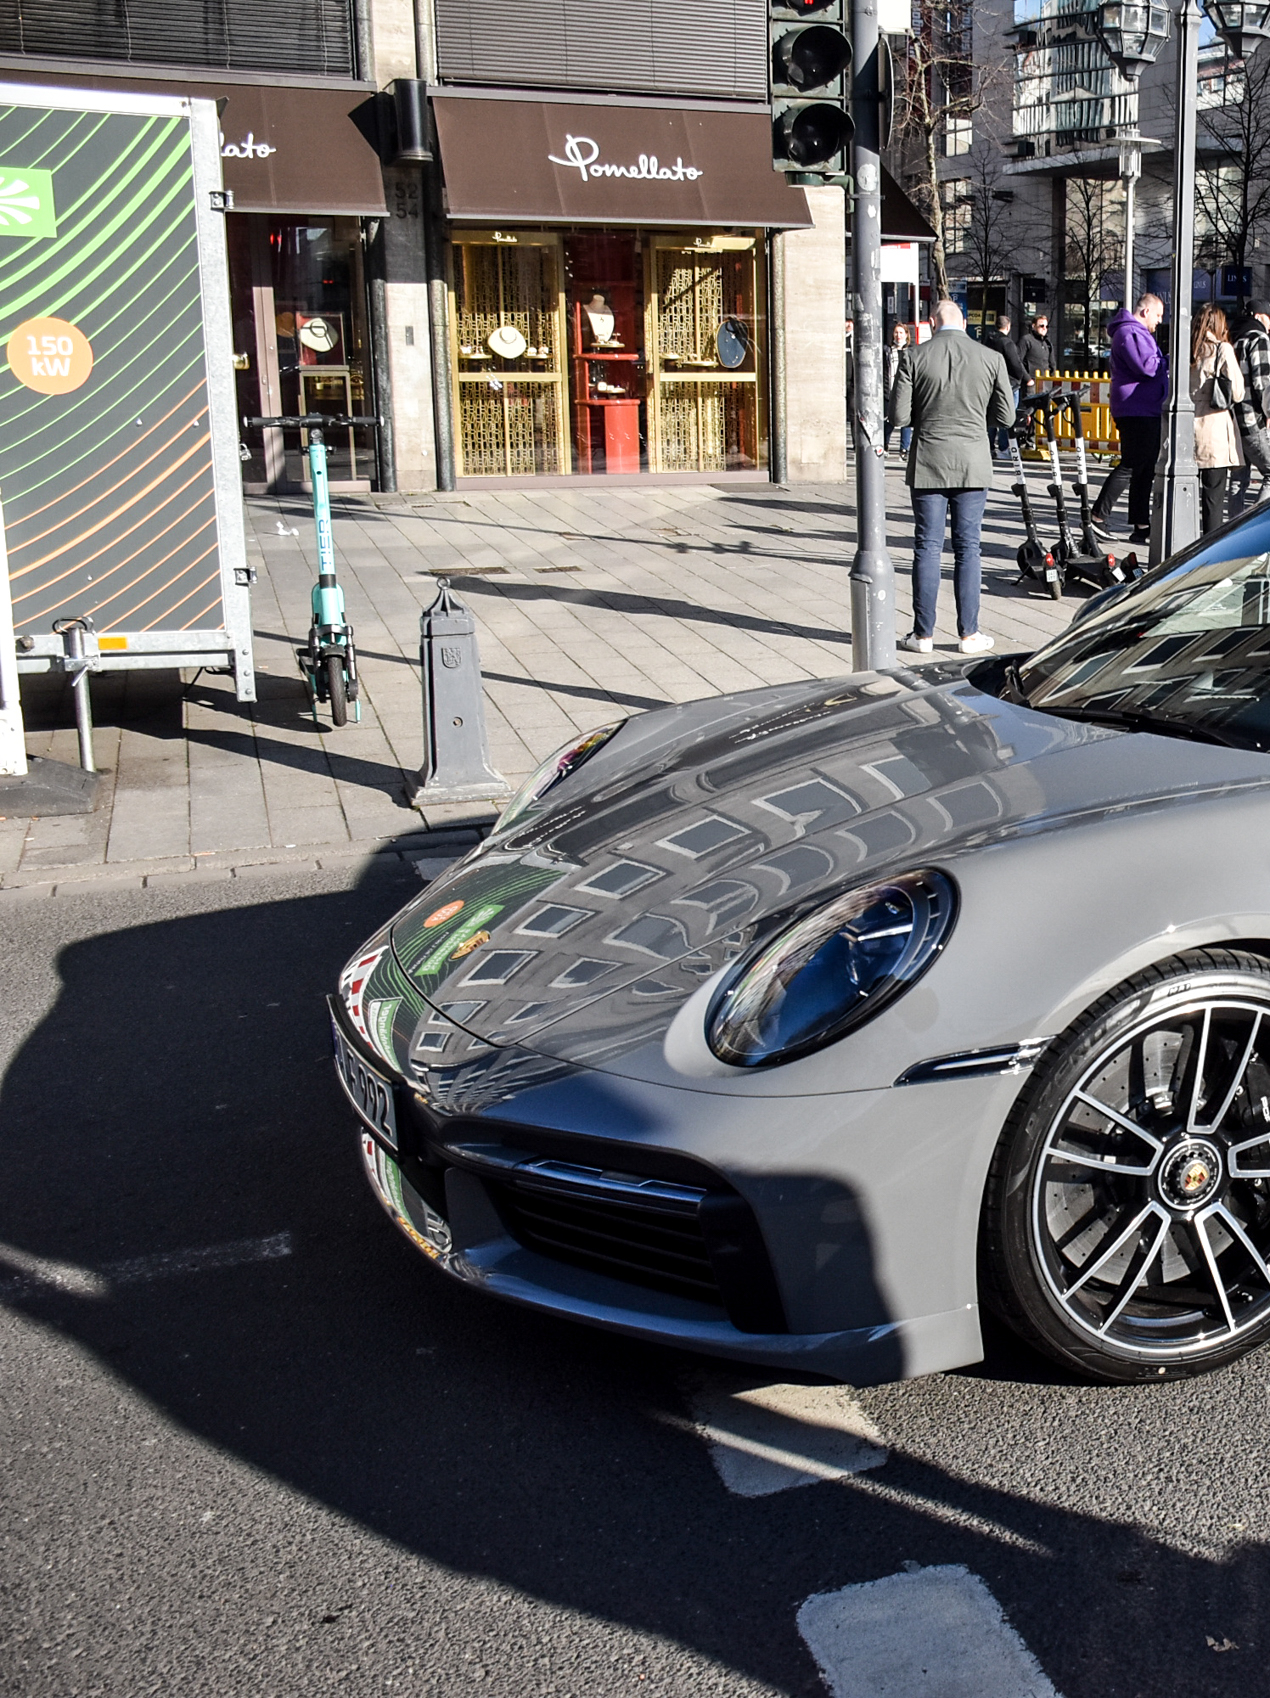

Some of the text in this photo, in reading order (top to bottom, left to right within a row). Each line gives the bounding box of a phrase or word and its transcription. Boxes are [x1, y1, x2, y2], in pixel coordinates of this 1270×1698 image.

[548, 133, 703, 181] Pomellato
[395, 182, 418, 199] 52
[396, 202, 419, 219] 54
[27, 335, 73, 355] 150
[31, 357, 71, 376] kW
[1011, 447, 1021, 475] BIRD
[318, 519, 332, 571] TIER
[358, 1063, 393, 1137] 992
